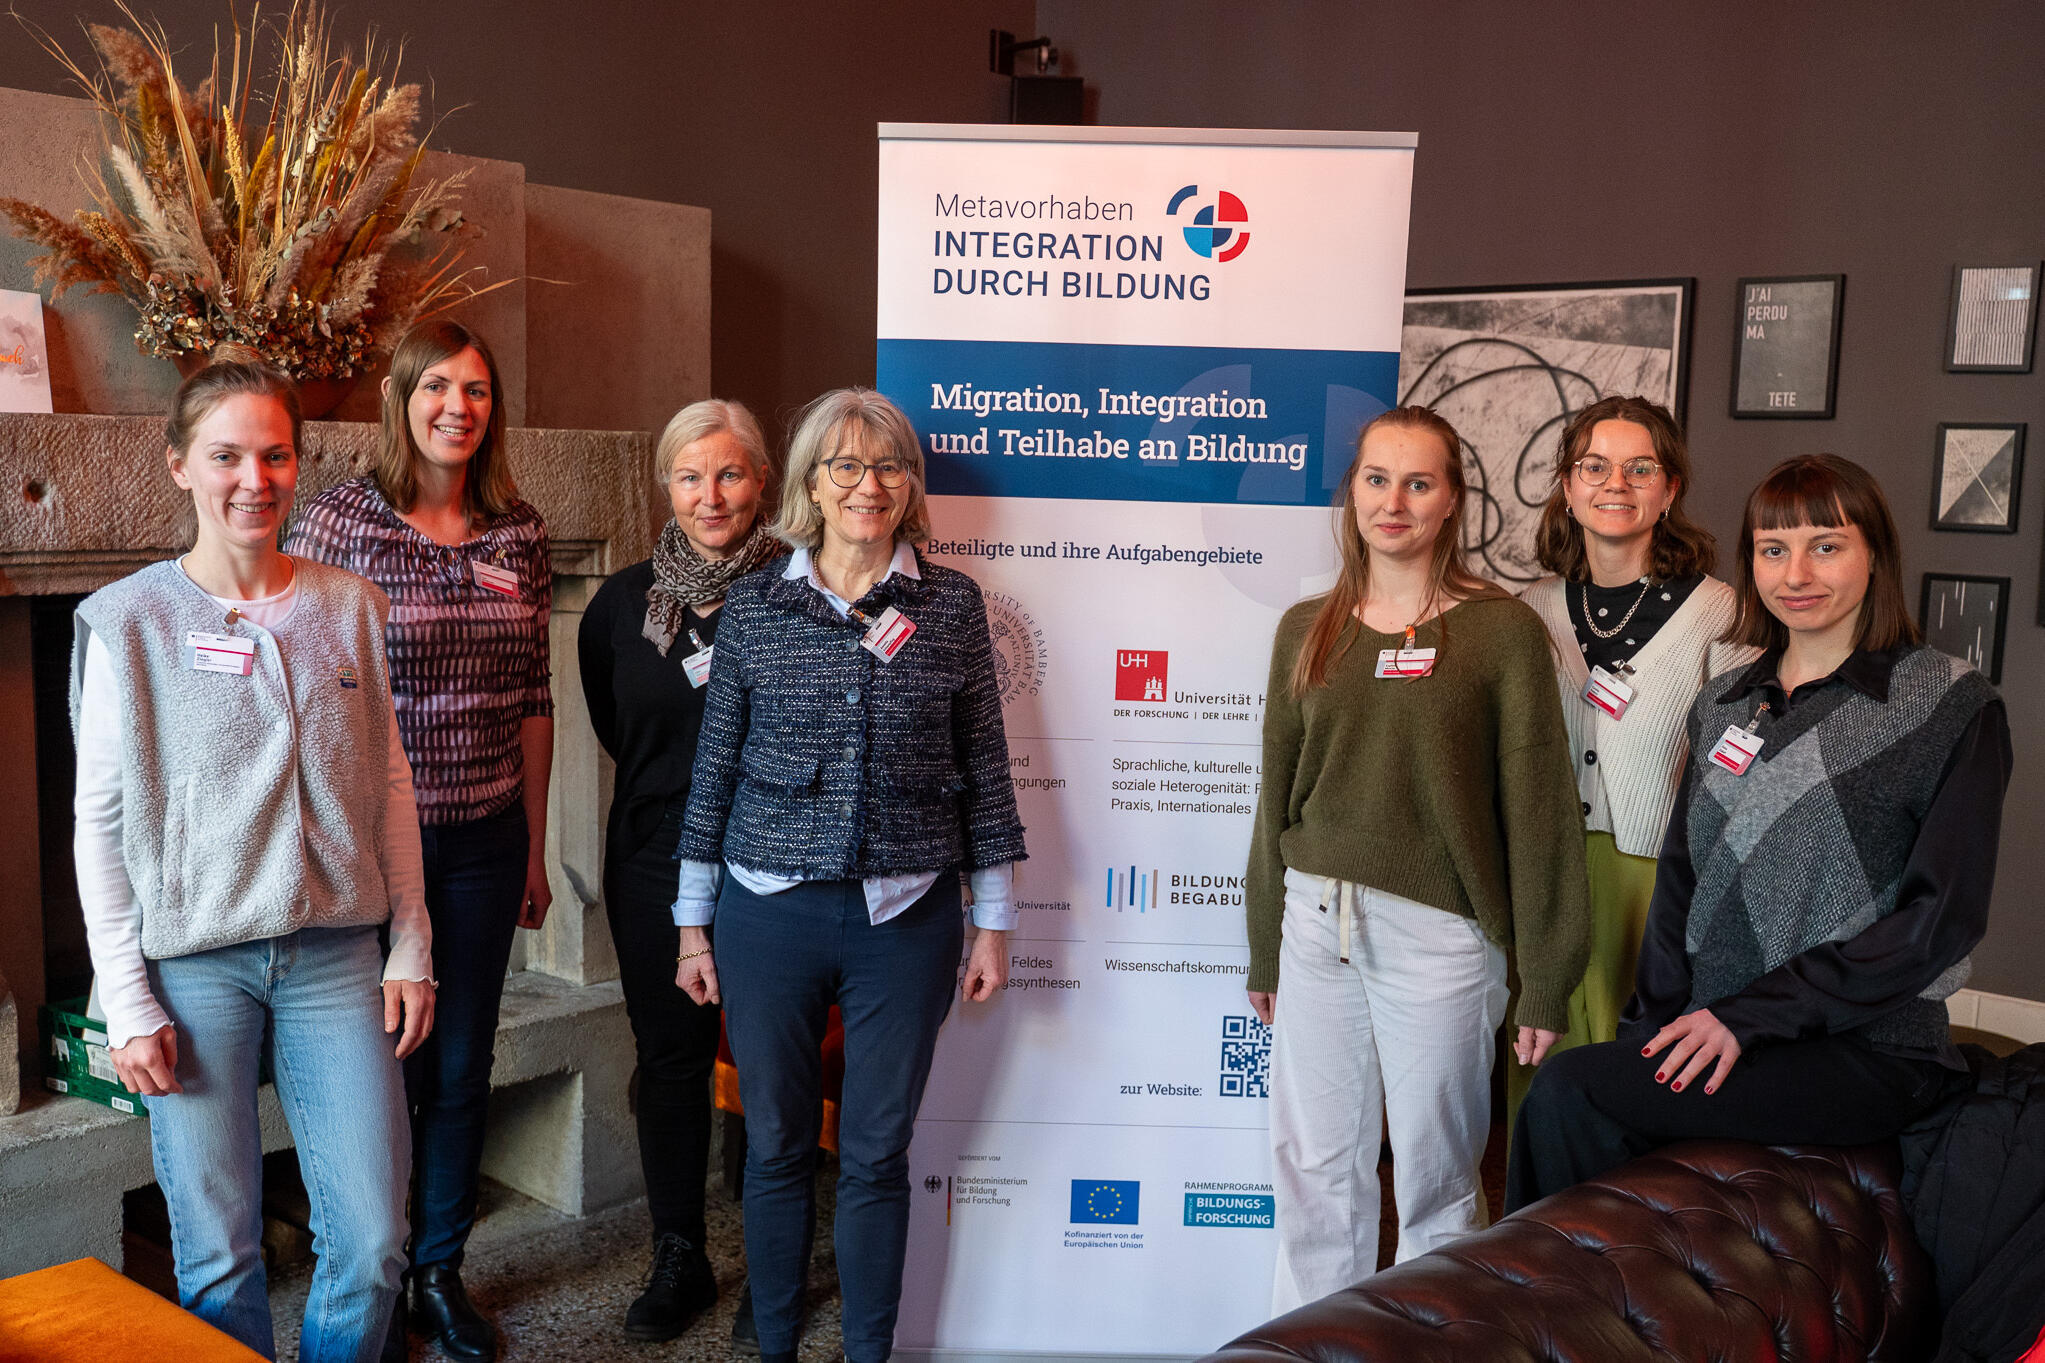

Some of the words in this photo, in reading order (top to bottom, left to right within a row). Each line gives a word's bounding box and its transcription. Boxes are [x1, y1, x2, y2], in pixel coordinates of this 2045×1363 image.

[935, 193, 1133, 221] Metavorhaben
[934, 231, 1163, 261] INTEGRATION
[933, 269, 1048, 297] DURCH
[1062, 271, 1211, 300] BILDUNG
[1747, 305, 1788, 321] PERDU
[1746, 324, 1765, 339] MA
[931, 383, 1088, 418] Migration,
[1098, 388, 1267, 423] Integration
[930, 427, 989, 455] und
[999, 428, 1130, 460] Teilhabe
[1138, 438, 1178, 461] an
[1187, 434, 1308, 470] Bildung
[927, 539, 1014, 560] Beteiligte
[1021, 542, 1057, 558] und
[1062, 542, 1100, 560] ihre
[1106, 544, 1263, 566] Aufgabengebiete
[984, 590, 1022, 611] RSITY
[1023, 613, 1035, 626] OF
[1029, 629, 1048, 697] BAMBERG
[988, 605, 1035, 679] -UNIVERSITÄT
[1174, 691, 1251, 706] Universität
[1113, 709, 1131, 717] DER
[1134, 710, 1189, 719] FORSCHUNG
[1202, 712, 1219, 720] DER
[1223, 713, 1249, 721] LEHRE
[1112, 758, 1190, 774] Sprachliche,
[1194, 760, 1252, 774] kulturelle
[1011, 777, 1066, 791] ngungen
[1112, 779, 1156, 791] soziale
[1160, 780, 1250, 795] Heterogenität:
[1111, 798, 1153, 813] Praxis,
[1157, 800, 1251, 814] Internationales
[1014, 901, 1071, 911] -Universität
[1170, 892, 1243, 906] BEGABU
[1011, 956, 1053, 968] Feldes
[1002, 976, 1081, 990] gssynthesen
[1120, 1084, 1143, 1095] zur
[1147, 1083, 1203, 1096] Website:
[956, 1176, 1028, 1185] Bundesministerium
[956, 1186, 967, 1194] für
[969, 1186, 997, 1196] Bildung
[956, 1196, 970, 1204] und
[972, 1196, 1011, 1206] Forschung
[1196, 1197, 1265, 1209] BILDUNGS-
[1195, 1213, 1271, 1224] FORSCHUNG
[1064, 1231, 1112, 1239] Kofinanziert
[1130, 1232, 1144, 1240] der
[1064, 1240, 1118, 1249] Europäischen
[1120, 1241, 1144, 1249] Union
